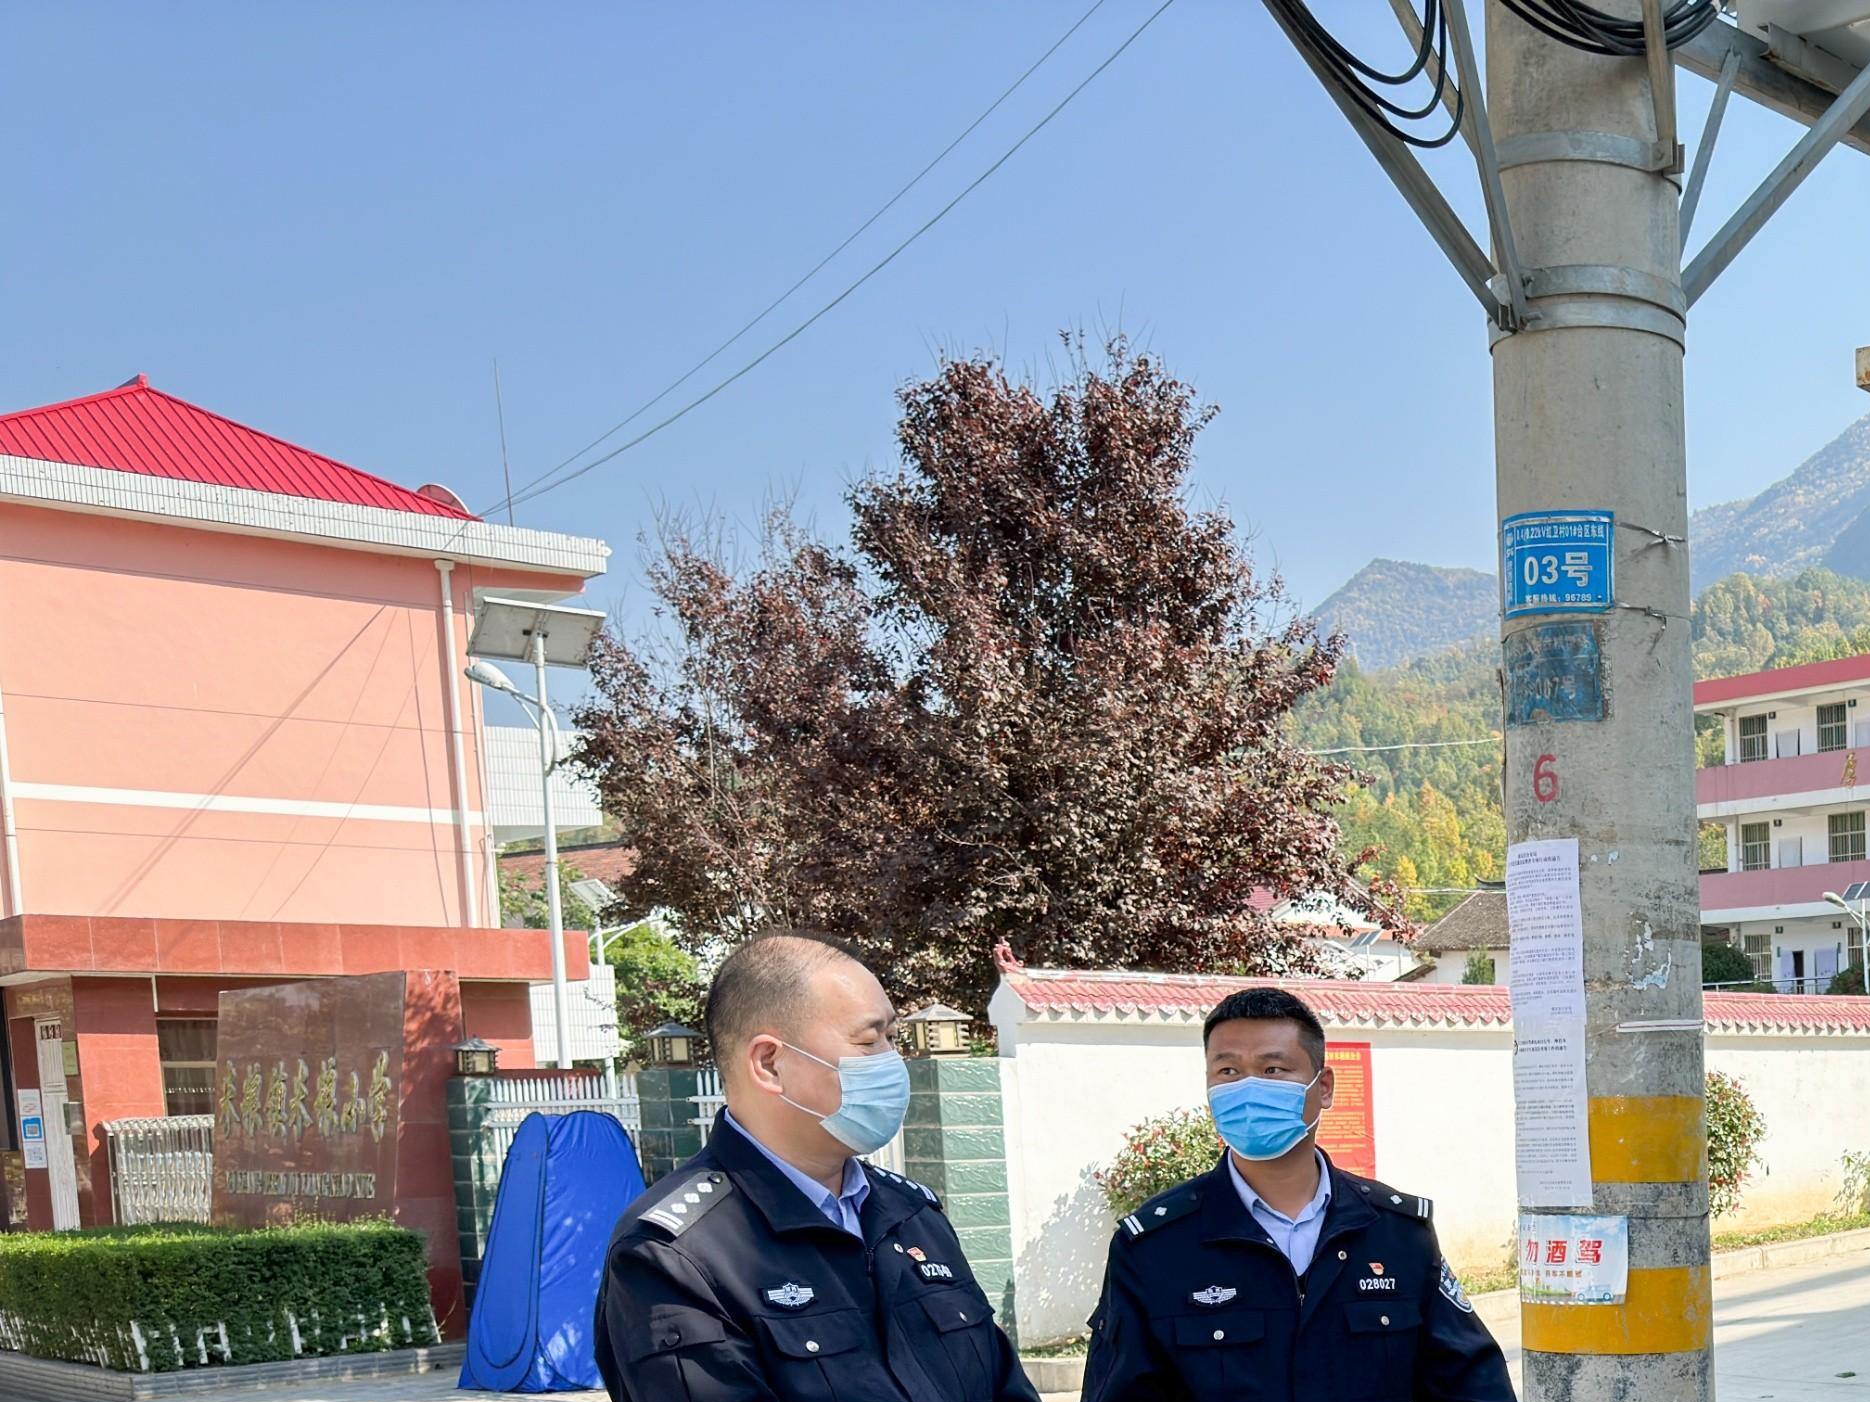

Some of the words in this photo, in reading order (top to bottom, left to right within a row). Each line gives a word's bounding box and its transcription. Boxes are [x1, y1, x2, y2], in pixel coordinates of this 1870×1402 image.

[1524, 551, 1593, 587] 03号
[1533, 753, 1559, 804] 6
[1520, 1239, 1603, 1265] 勿酒驾
[1360, 1278, 1396, 1290] 028027
